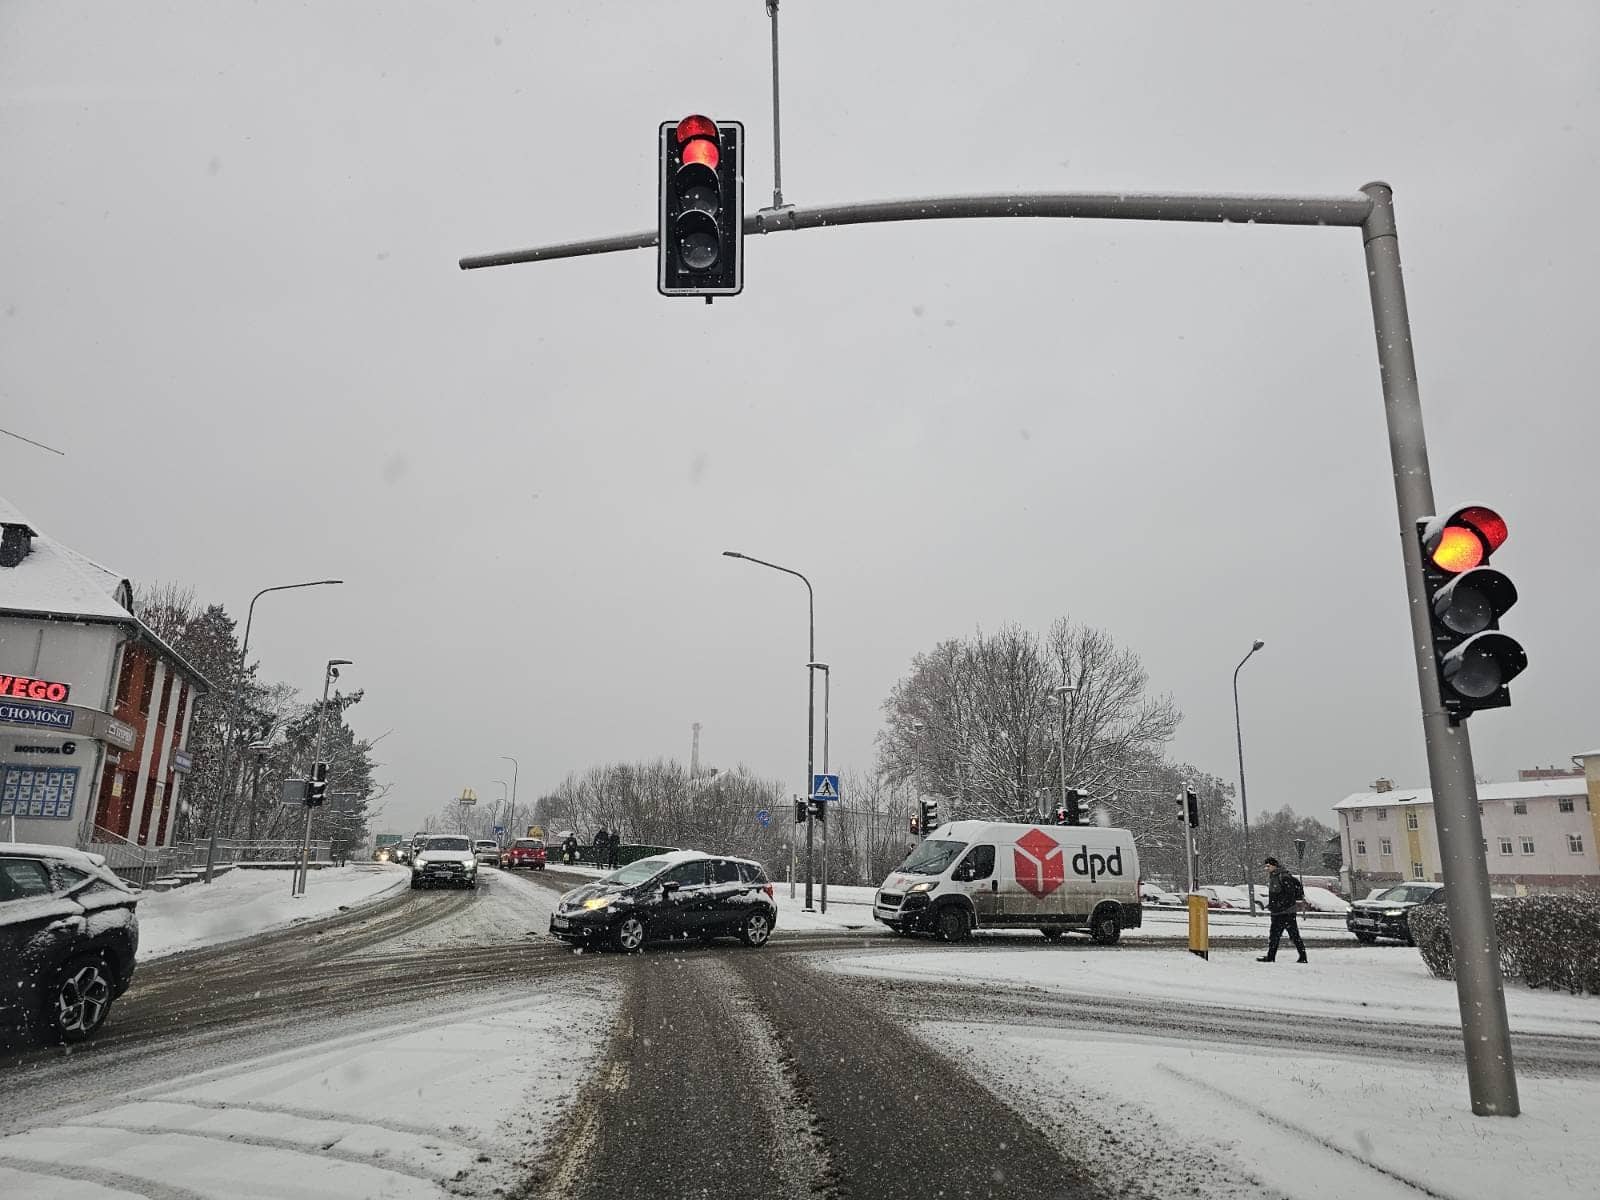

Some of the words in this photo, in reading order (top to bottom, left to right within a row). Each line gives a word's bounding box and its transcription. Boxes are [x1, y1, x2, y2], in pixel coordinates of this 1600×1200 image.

[0, 706, 70, 725] CHOMOŚCI
[62, 741, 76, 755] 6
[1072, 844, 1123, 883] dpd
